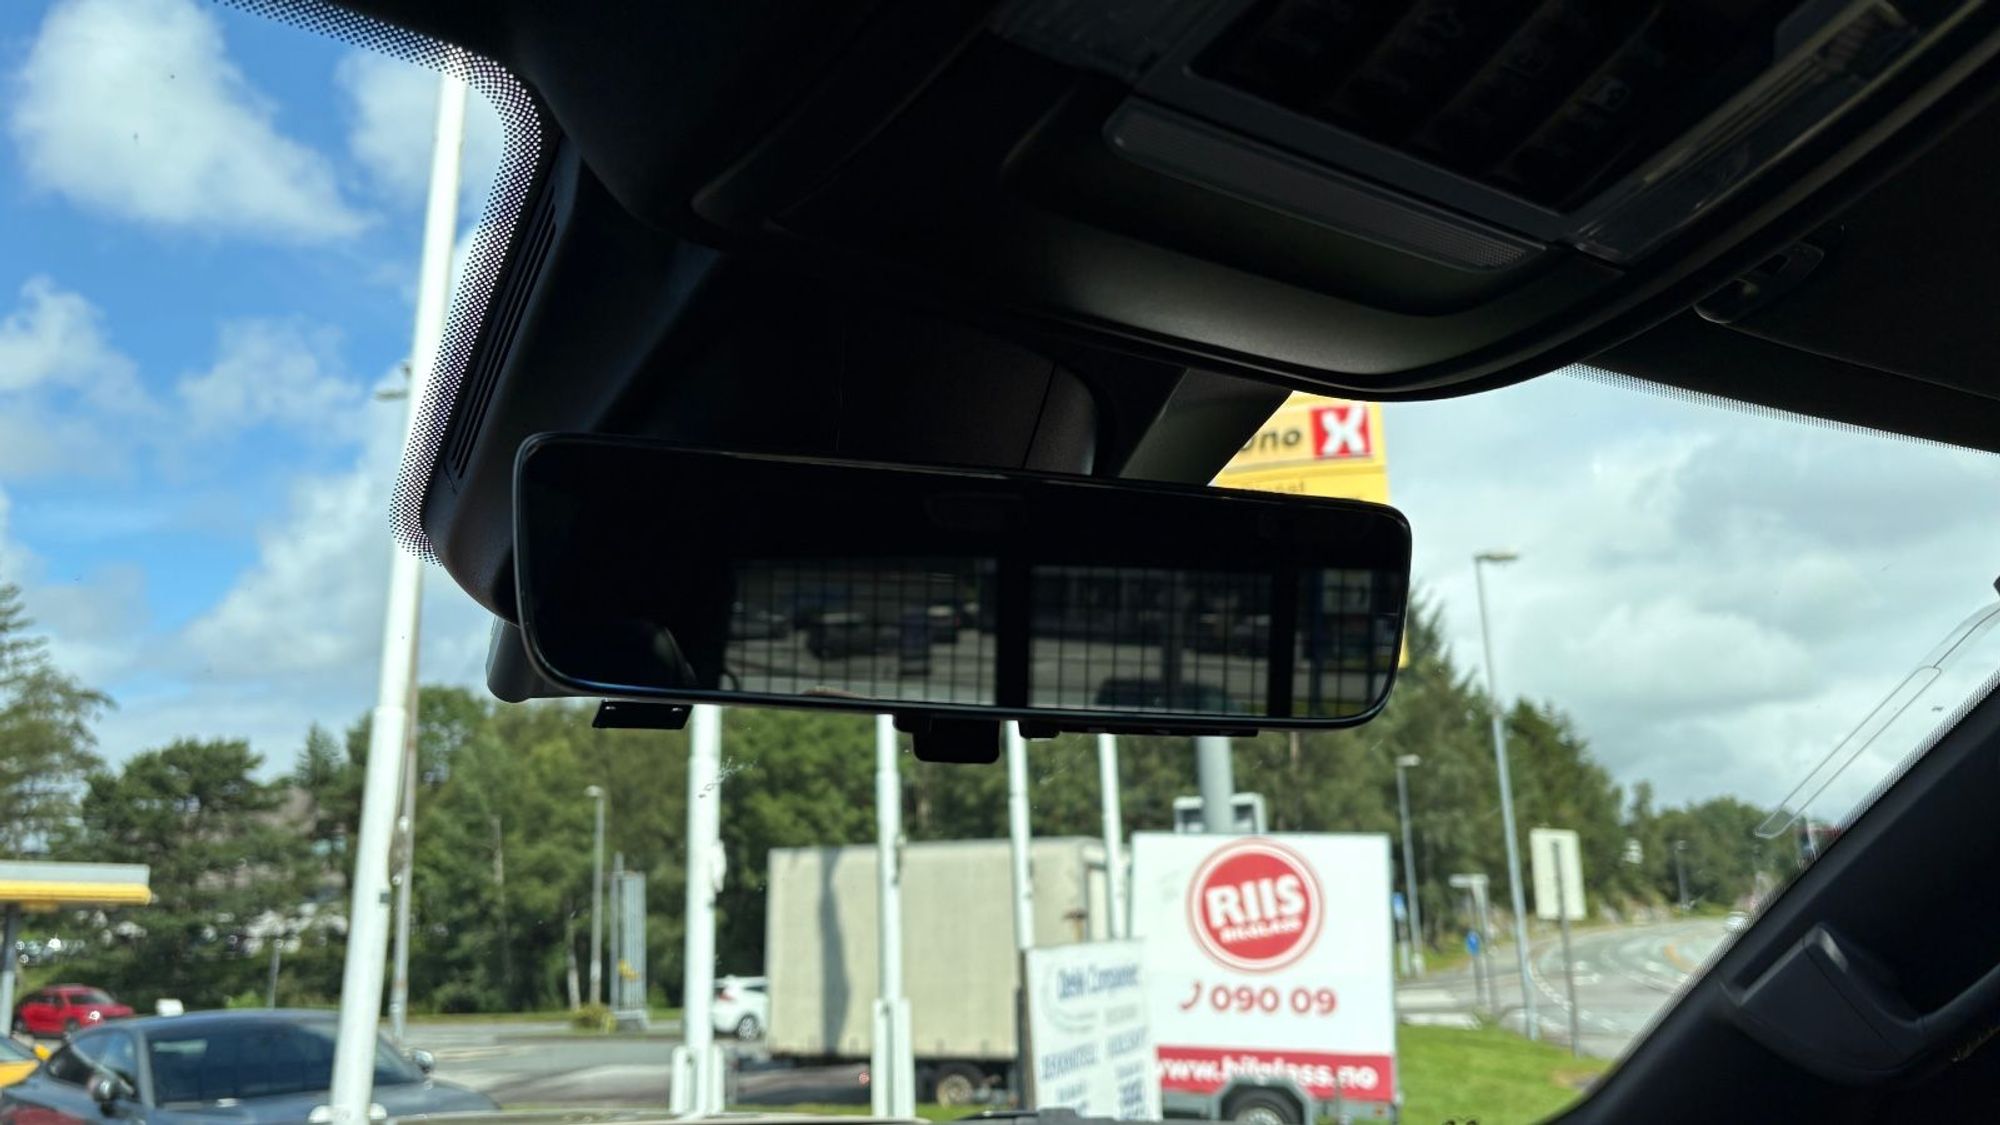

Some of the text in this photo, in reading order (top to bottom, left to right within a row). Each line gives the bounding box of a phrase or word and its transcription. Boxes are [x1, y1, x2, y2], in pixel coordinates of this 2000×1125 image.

[1206, 873, 1305, 928] RIIS
[1210, 985, 1337, 1015] 090 09
